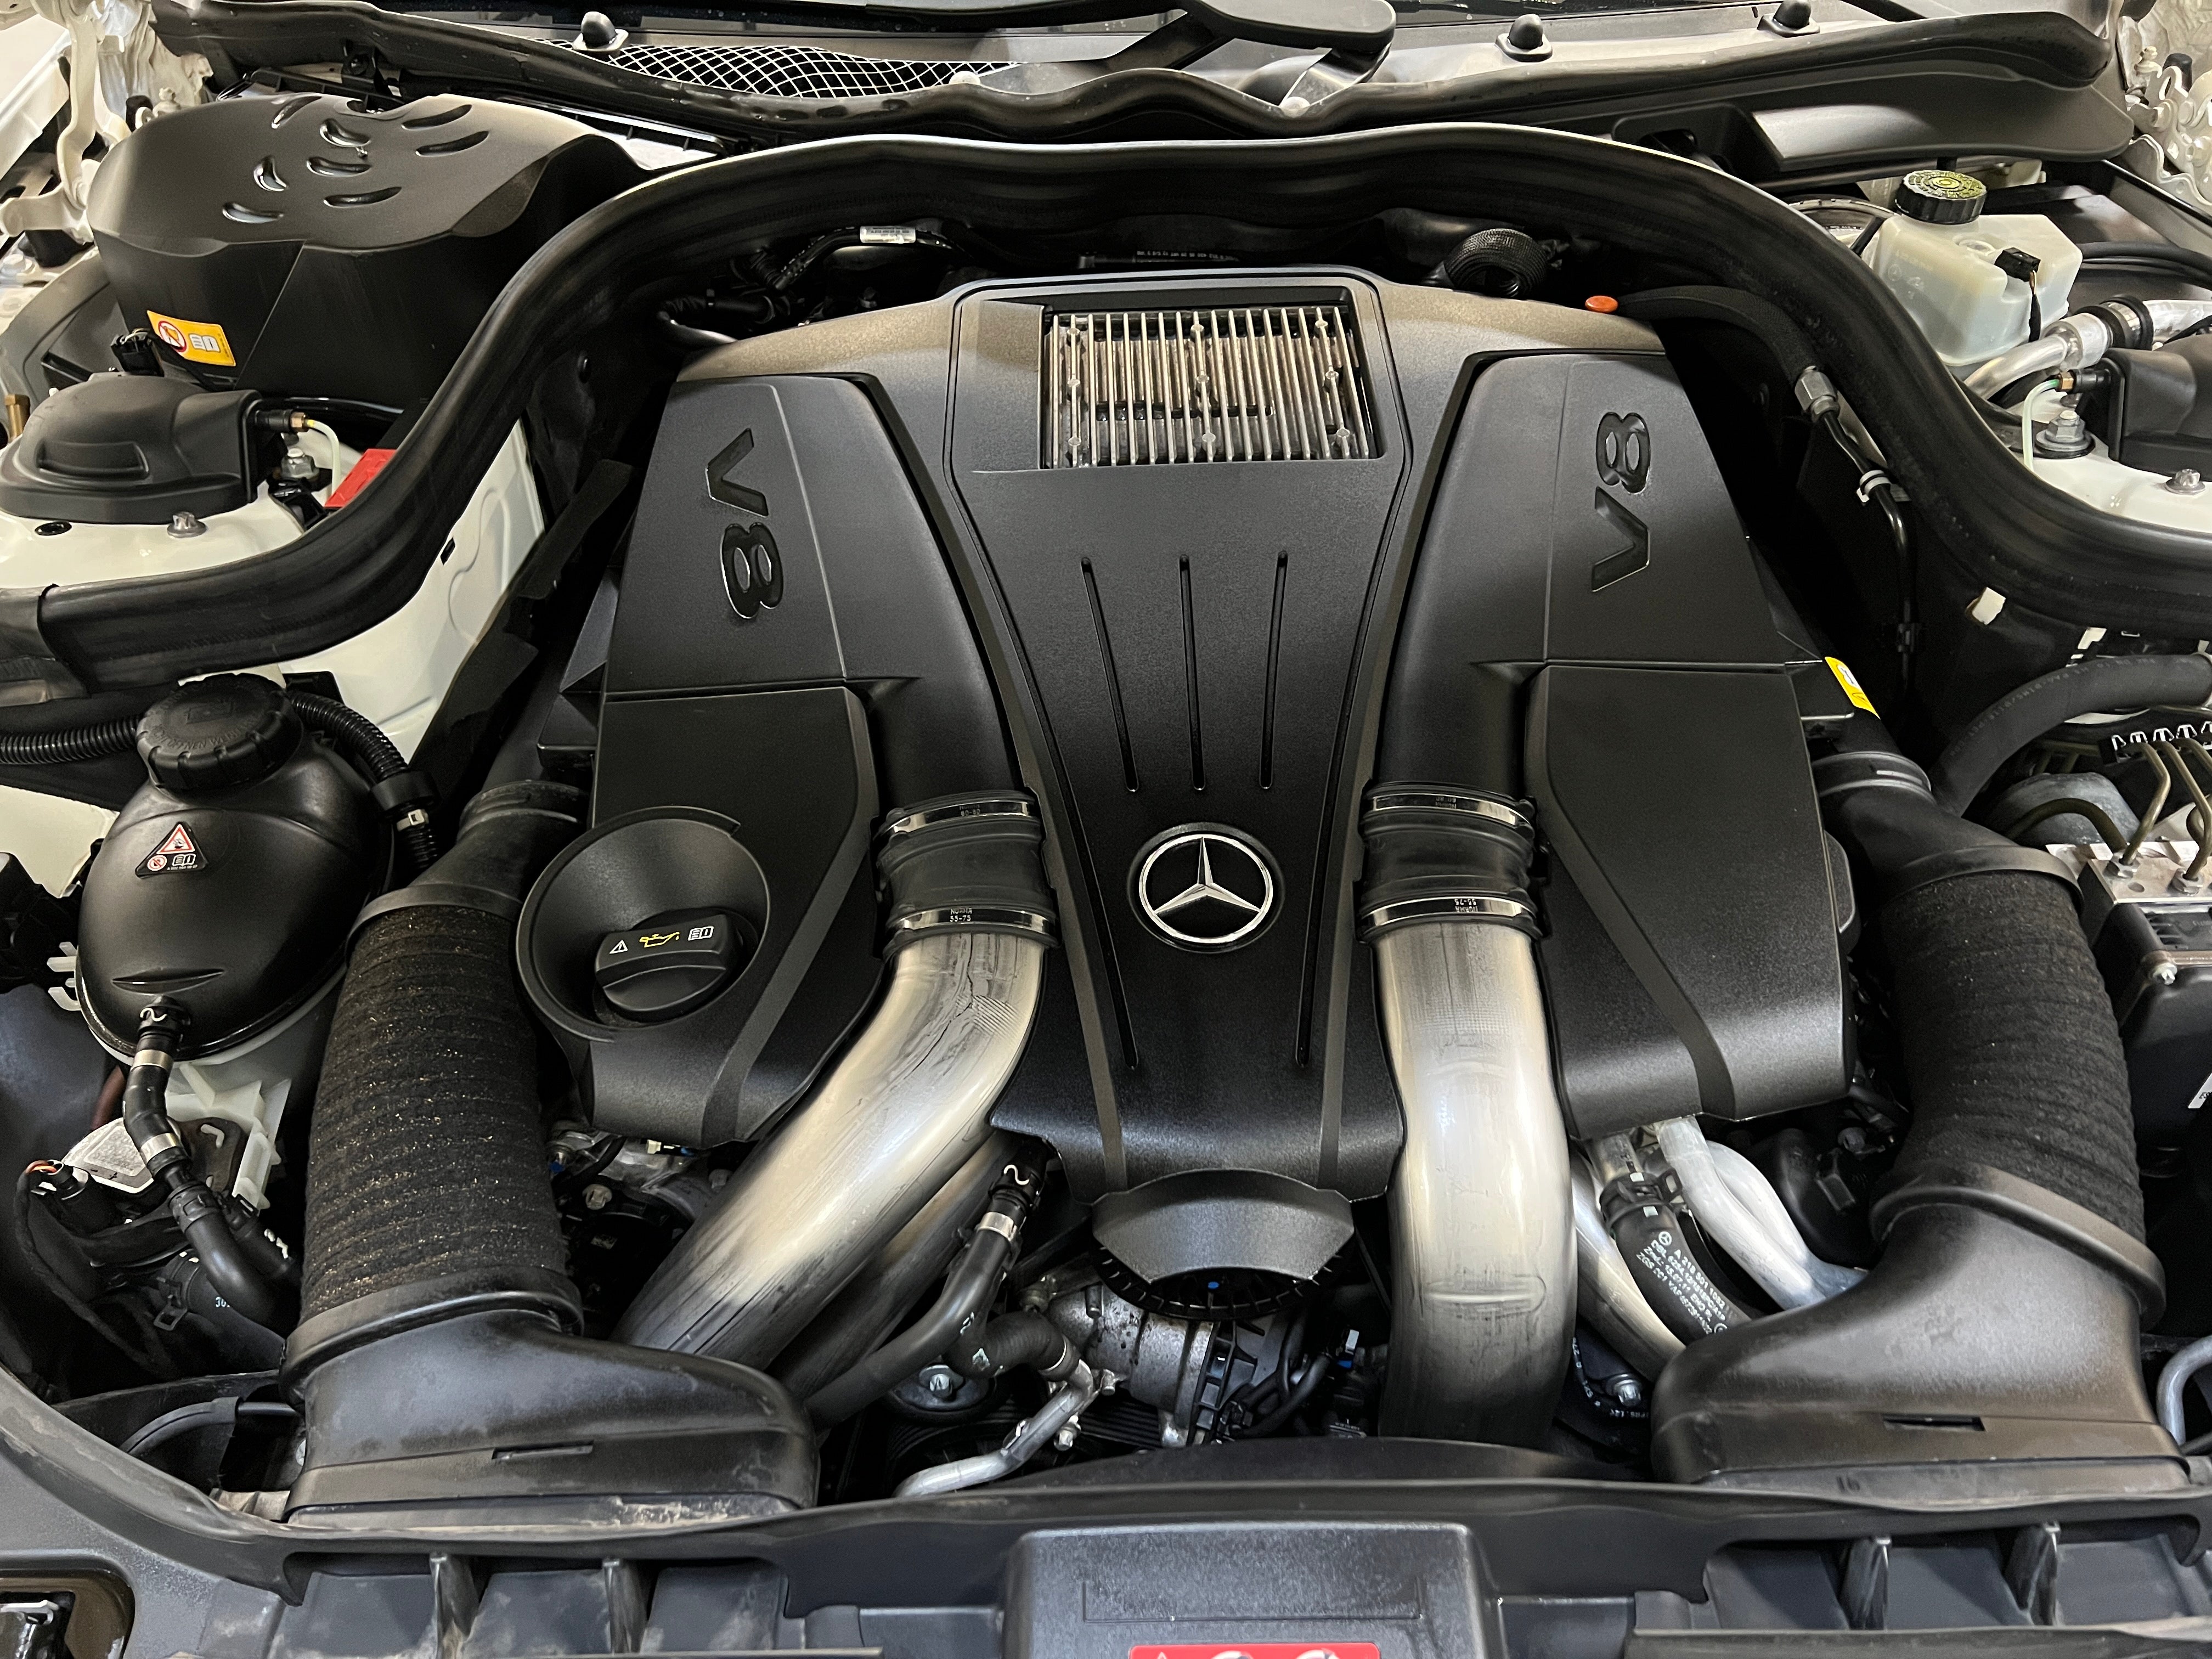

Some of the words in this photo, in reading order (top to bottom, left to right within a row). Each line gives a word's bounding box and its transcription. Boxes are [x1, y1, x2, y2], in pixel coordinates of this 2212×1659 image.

[705, 427, 784, 619] V8
[1592, 411, 1651, 593] V8
[1674, 1249, 1681, 1260] A
[1681, 1256, 1696, 1274] 218
